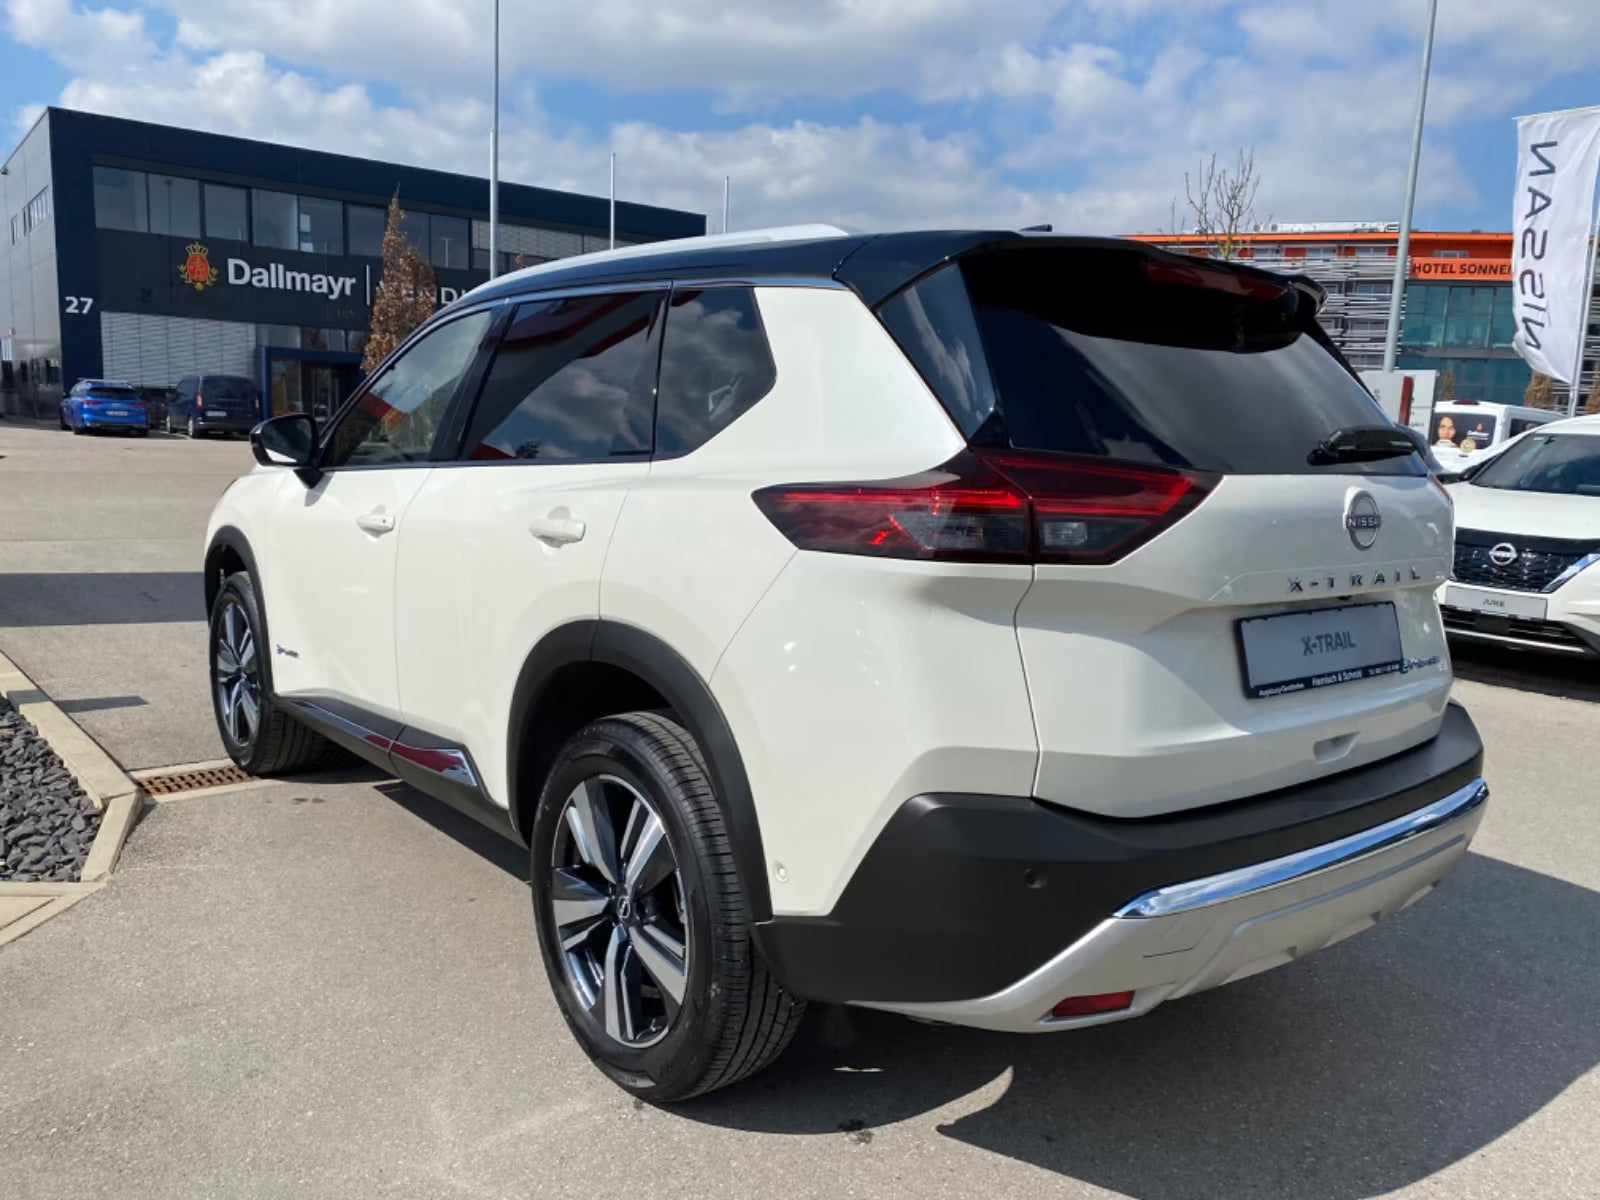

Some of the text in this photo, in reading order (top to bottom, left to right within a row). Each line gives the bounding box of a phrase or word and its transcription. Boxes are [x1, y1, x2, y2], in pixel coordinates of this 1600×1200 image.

[227, 258, 357, 300] Dallmayr
[1412, 263, 1456, 274] HOTEL
[65, 296, 94, 314] 27
[1288, 566, 1421, 592] X-TRAIL
[1301, 631, 1357, 656] X-TRAIL
